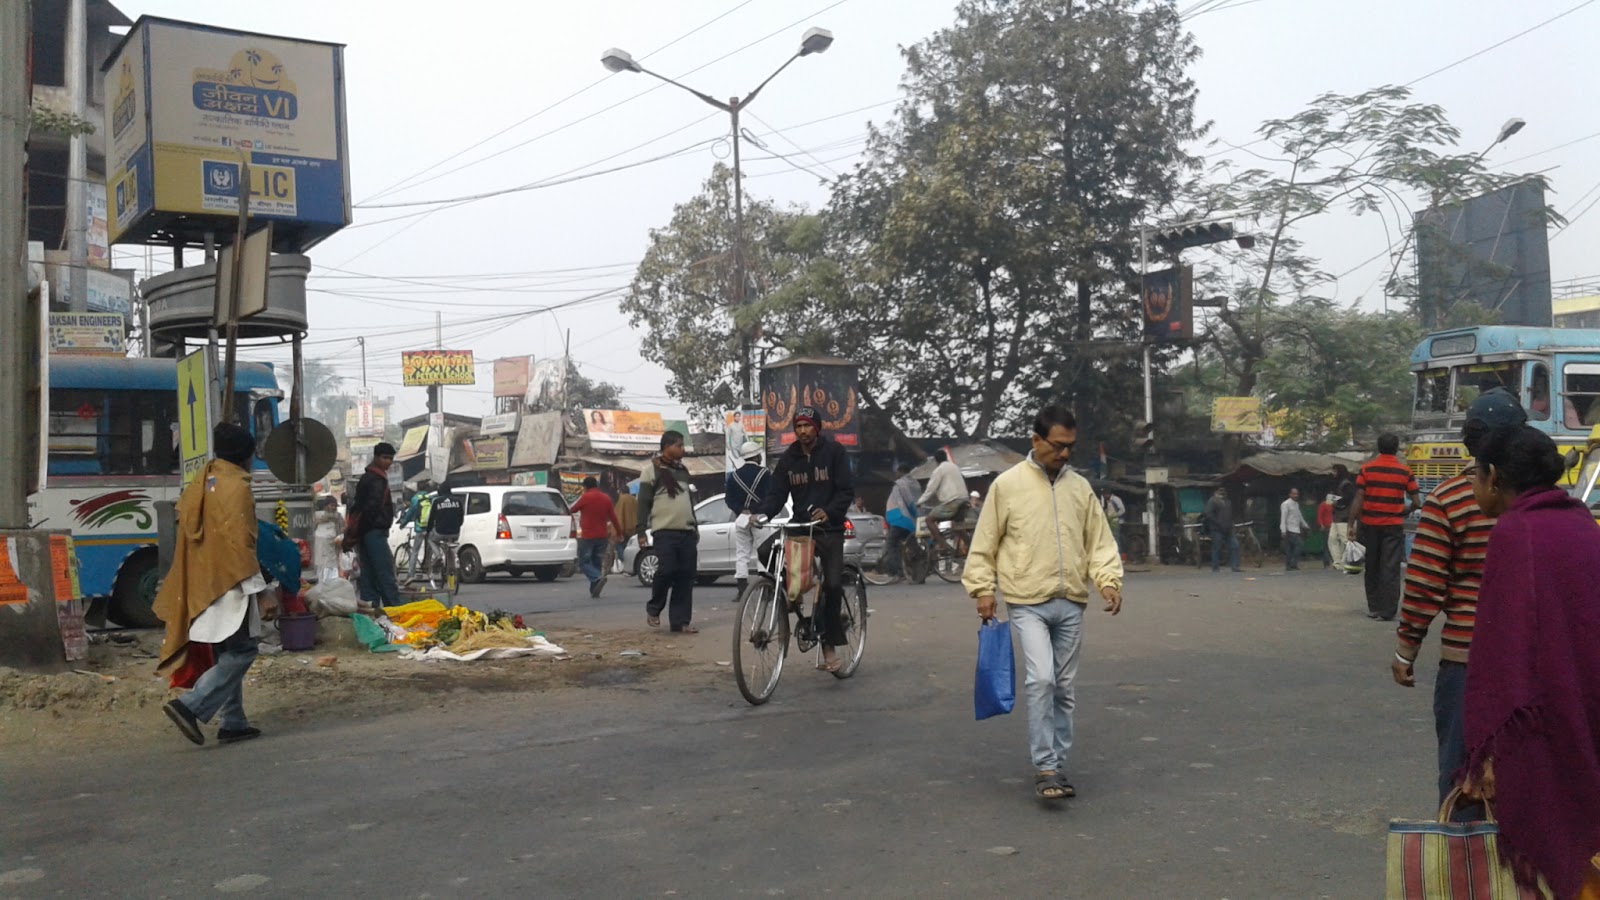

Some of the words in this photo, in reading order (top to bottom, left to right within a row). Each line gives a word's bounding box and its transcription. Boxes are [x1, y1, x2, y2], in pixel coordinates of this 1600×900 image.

[202, 84, 258, 104] जीवन
[263, 94, 290, 119] VI
[79, 315, 122, 327] ENGINEERS
[1432, 447, 1460, 455] TATA
[437, 501, 460, 510] ADIDAS
